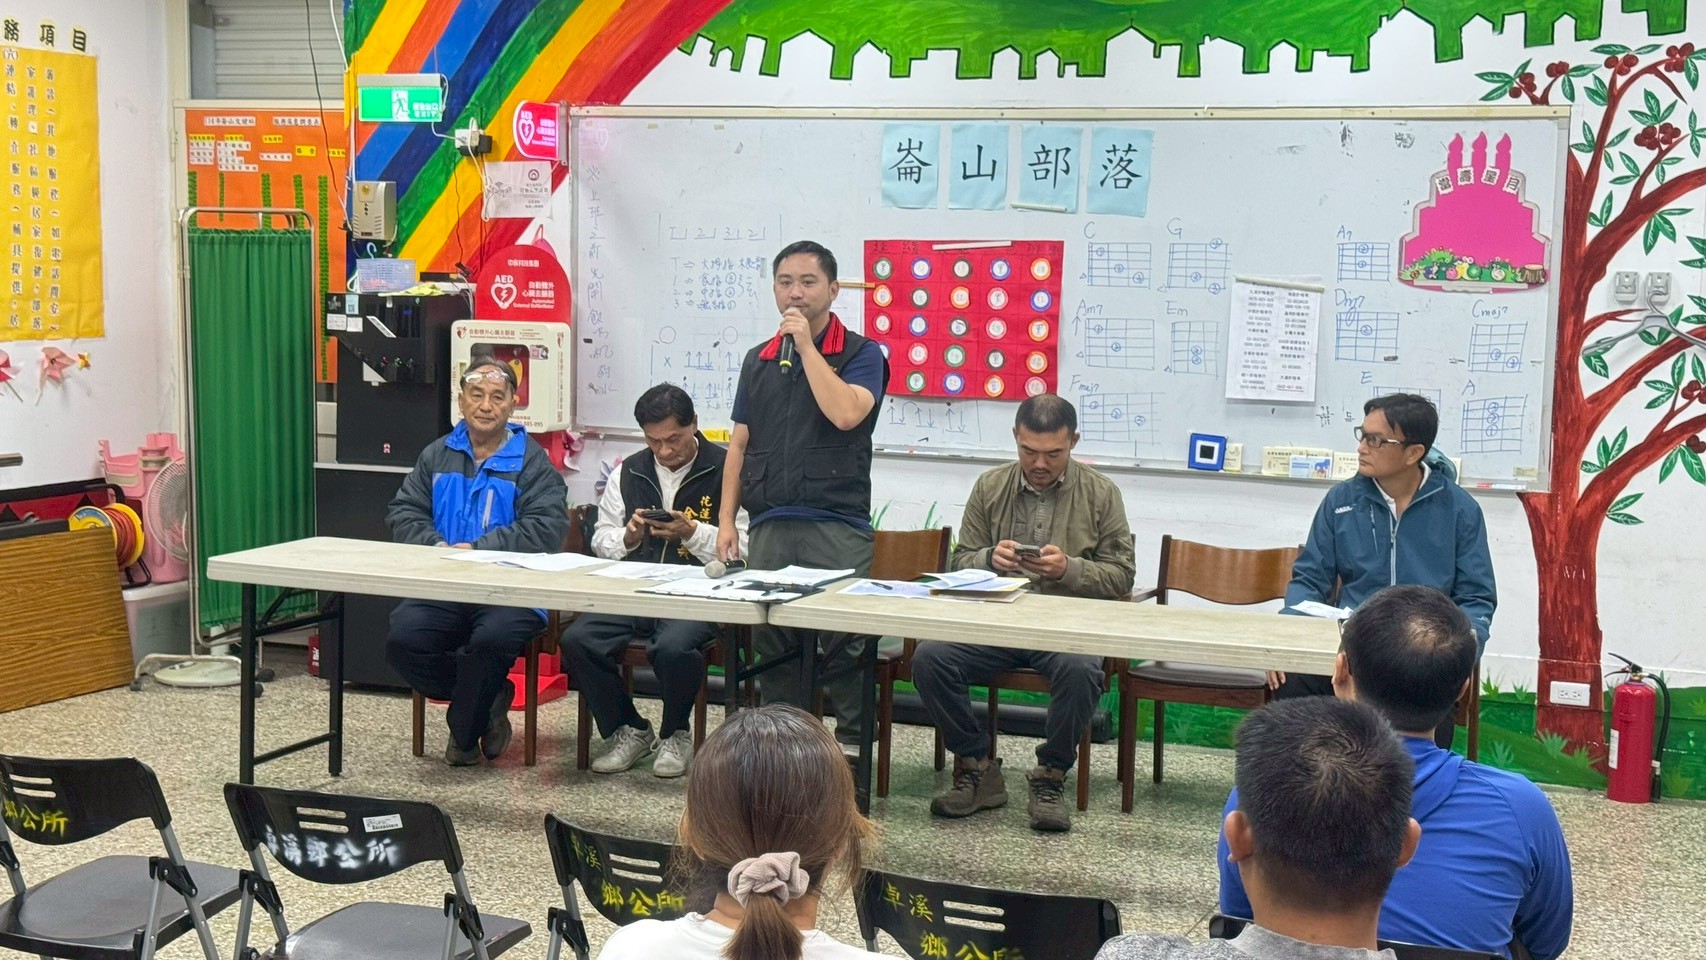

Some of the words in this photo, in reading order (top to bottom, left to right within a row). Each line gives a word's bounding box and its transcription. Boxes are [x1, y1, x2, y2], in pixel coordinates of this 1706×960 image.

[4, 19, 86, 52] 務項目
[888, 137, 1142, 190] 崙山部落
[1084, 221, 1096, 239] C
[1167, 218, 1183, 240] G
[494, 275, 513, 283] AED
[1166, 301, 1188, 317] Em
[1361, 371, 1372, 384] E
[1461, 379, 1476, 395] A
[700, 495, 713, 524] 花蓮
[602, 880, 686, 917] 鄉公所
[884, 883, 934, 922] 卓溪
